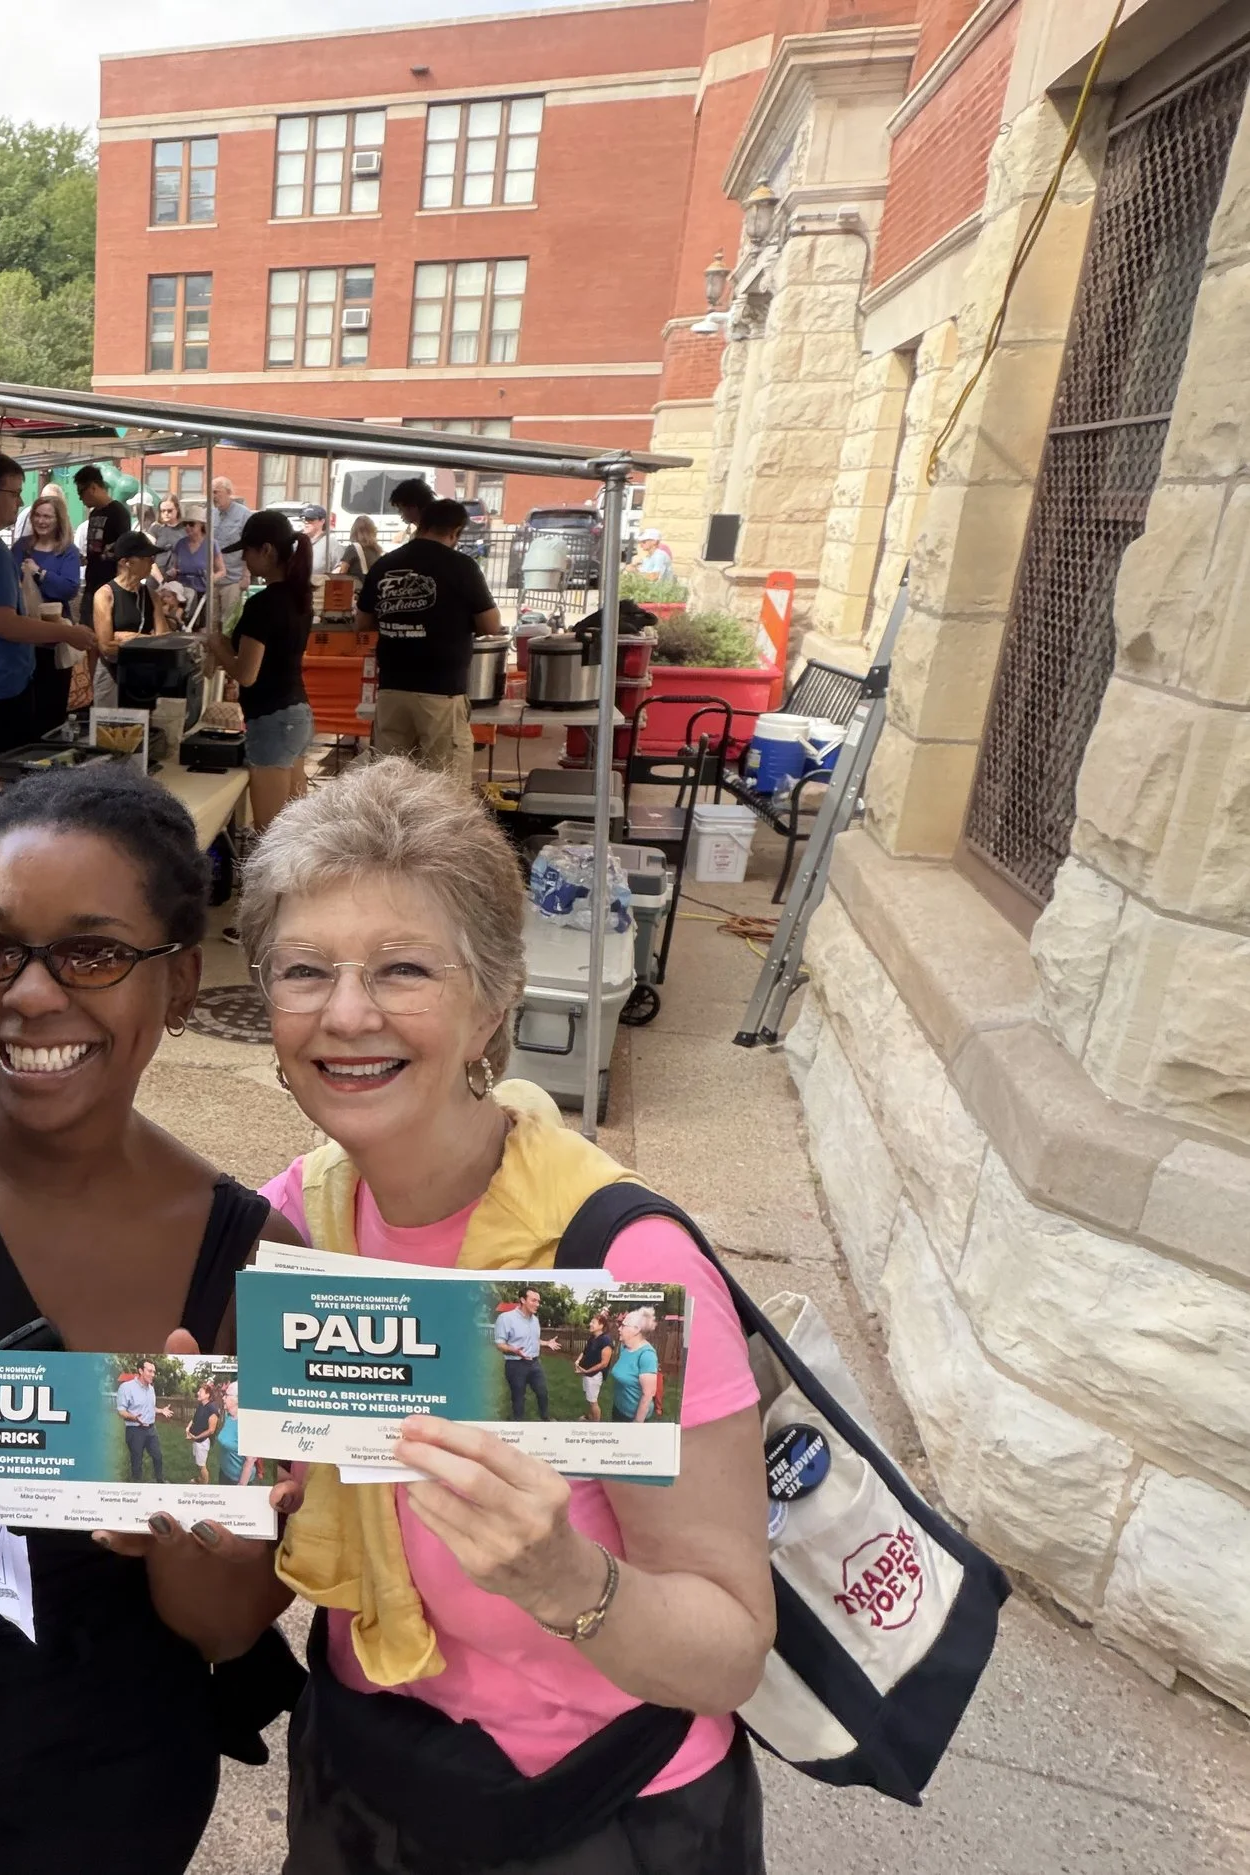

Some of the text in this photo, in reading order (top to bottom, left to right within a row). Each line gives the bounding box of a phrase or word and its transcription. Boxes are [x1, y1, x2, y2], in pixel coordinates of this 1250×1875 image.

[311, 1294, 361, 1302] DEMOCRATIC
[399, 1294, 412, 1304] for
[341, 1303, 408, 1311] REPRESENTATIVE
[283, 1312, 438, 1356] PAUL
[36, 1365, 46, 1374] for
[309, 1364, 405, 1380] KENDRICK
[272, 1387, 327, 1398] BUILDING
[341, 1392, 398, 1402] BRIGHTER
[401, 1395, 447, 1403] FUTURE
[288, 1399, 430, 1414] NEIGHBOR TO NEIGHBOR
[281, 1420, 330, 1436] Endorsed
[298, 1437, 314, 1452] by:
[769, 1443, 785, 1460] STAND
[784, 1429, 797, 1444] WITH
[7, 1466, 60, 1475] NEIGHBOR
[769, 1458, 789, 1481] THE
[772, 1435, 823, 1496] BROADVIEW
[785, 1477, 803, 1498] SIX
[80, 1515, 103, 1523] Hopkins
[834, 1525, 914, 1615] TRADER
[868, 1554, 921, 1626] JOE'S
